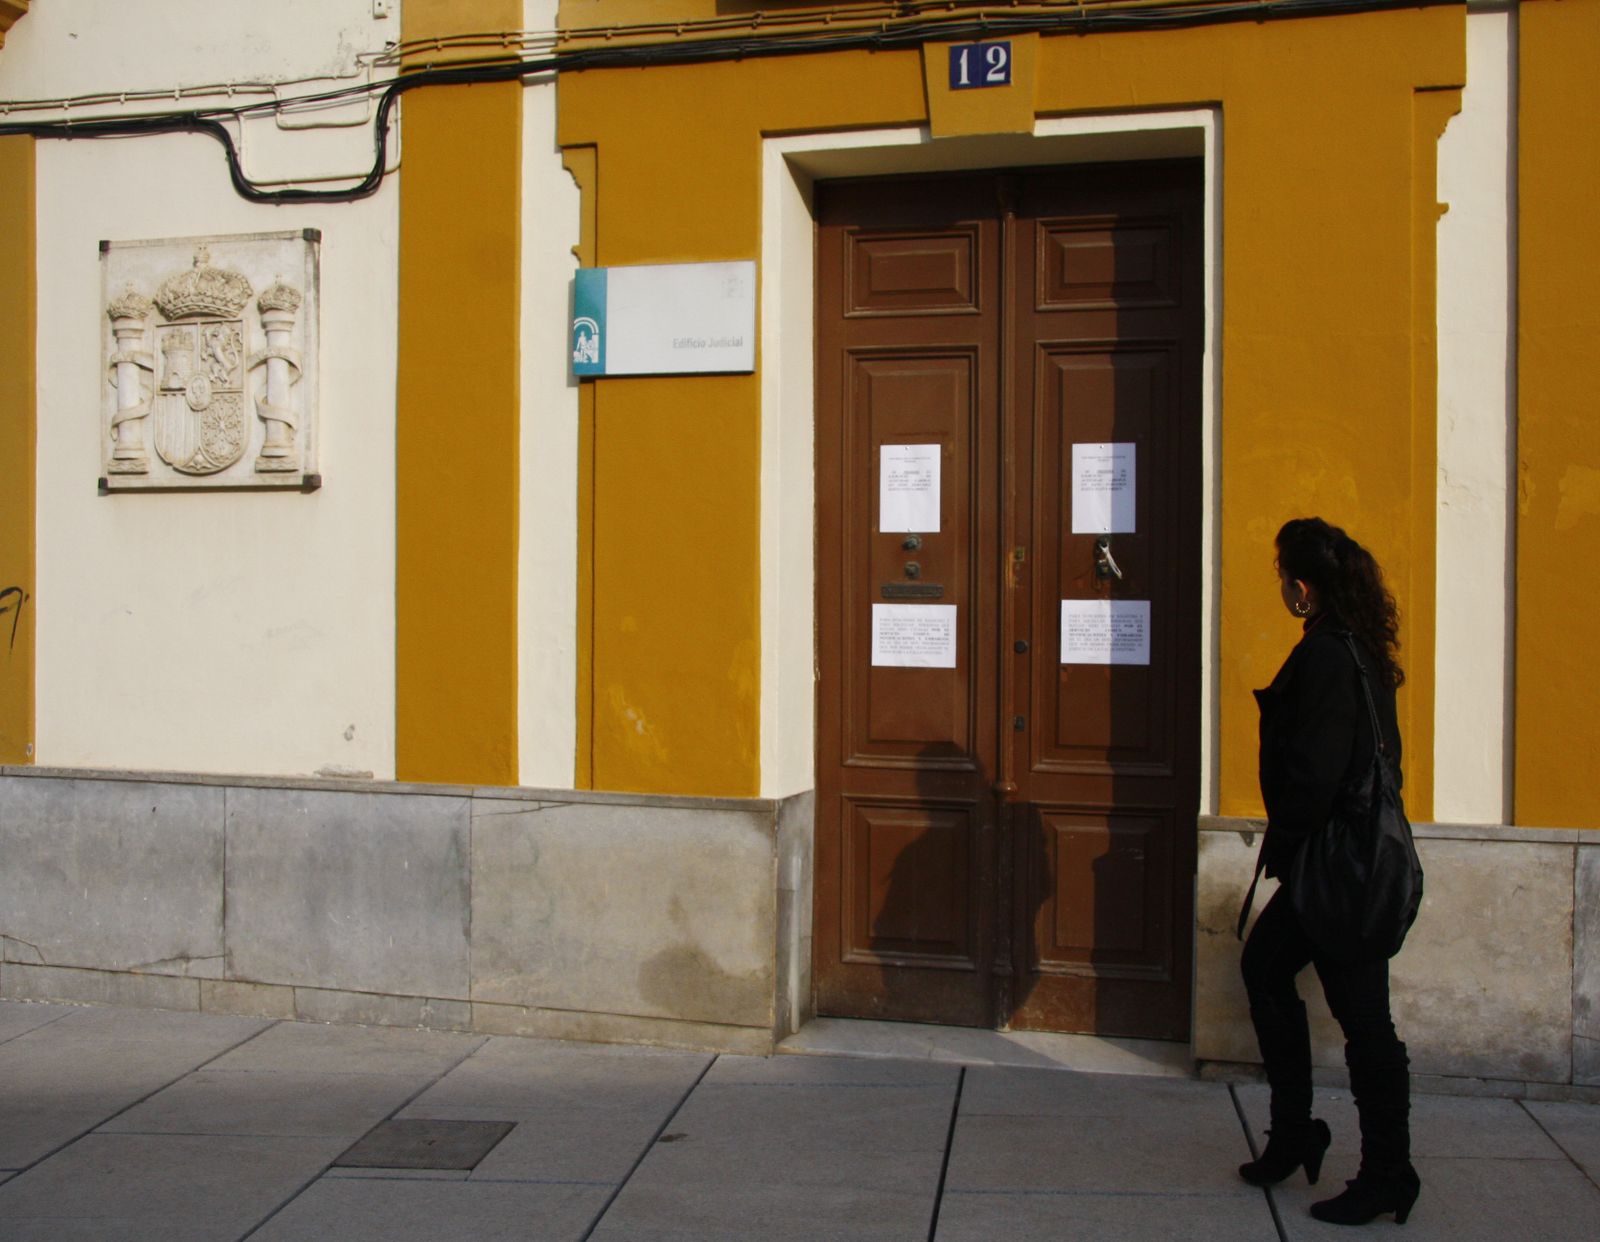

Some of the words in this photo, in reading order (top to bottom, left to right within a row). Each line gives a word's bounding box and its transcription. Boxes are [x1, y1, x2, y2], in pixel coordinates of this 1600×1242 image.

[959, 45, 1007, 85] 12
[672, 336, 706, 349] Edificio
[707, 335, 743, 348] Judicial
